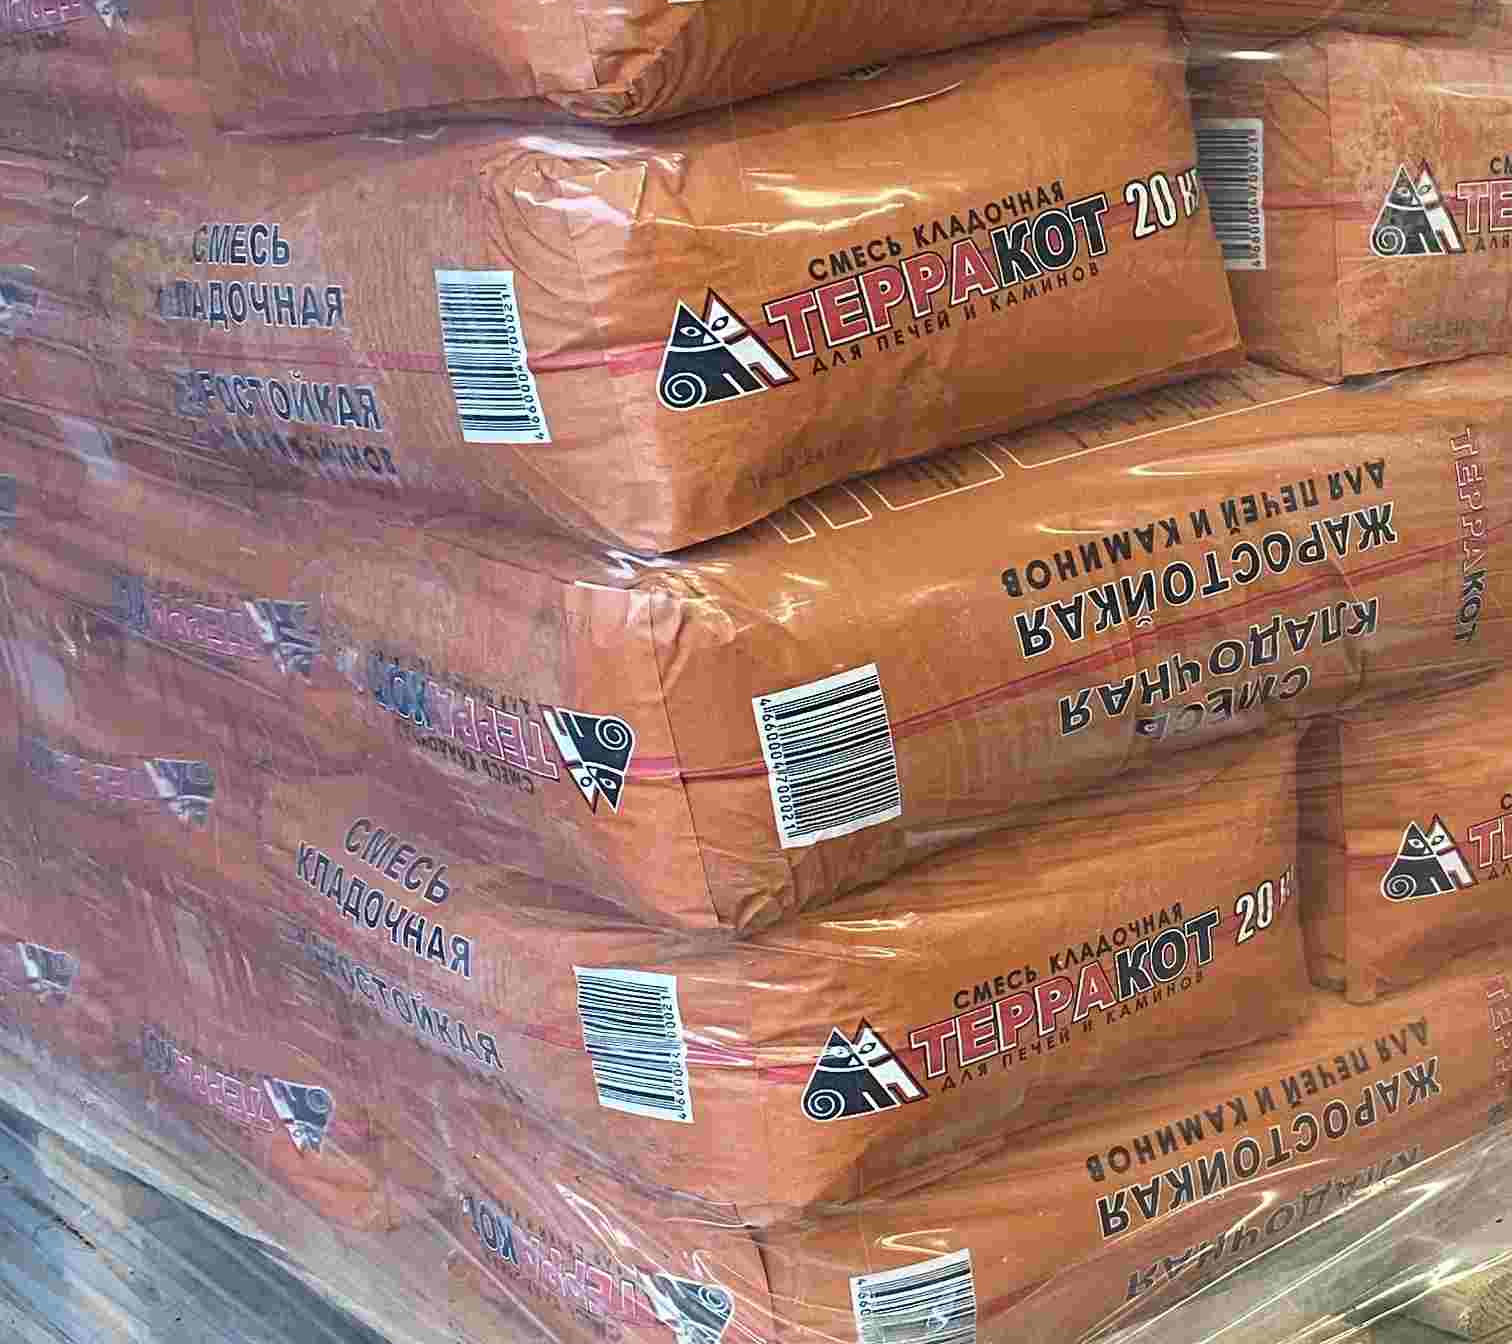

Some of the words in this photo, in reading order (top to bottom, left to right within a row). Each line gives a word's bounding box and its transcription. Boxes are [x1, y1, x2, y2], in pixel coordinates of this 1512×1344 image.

[191, 224, 290, 268] СМЕСЬ
[763, 193, 1109, 358] ТЕРРАКОТ
[1124, 171, 1176, 241] 20
[807, 236, 901, 281] СМЕСЬ
[912, 181, 1065, 247] КЛАДОЧНАЯ
[1474, 235, 1511, 252] ДЛЯ
[811, 341, 863, 376] ДЛЯ
[876, 312, 952, 351] ПЕЧЕЙ
[964, 301, 977, 321] И
[990, 261, 1100, 313] КАМИНОВ
[1192, 510, 1210, 533] И
[1221, 480, 1319, 532] ПЕЧЕЙ
[1327, 457, 1386, 498] ДЛЯ
[1000, 518, 1182, 597] КАМИНОВ
[1013, 502, 1398, 659] ЖАРОСТОЙКАЯ
[1057, 597, 1378, 737] КЛАДОЧНАЯ
[344, 817, 450, 905] СМЕСЬ
[295, 840, 472, 980] КЛАДОЧНАЯ
[954, 969, 1037, 1012] СМЕСЬ
[1048, 902, 1184, 973] КЛАДОЧНАЯ
[908, 909, 1220, 1080] ТЕРРАКОТ
[1234, 880, 1276, 944] 20
[940, 1062, 991, 1093] ДЛЯ
[999, 1026, 1072, 1075] ПЕЧЕЙ
[1106, 972, 1203, 1025] КАМИНОВ
[1285, 1045, 1366, 1105] ПЕЧЕЙ
[1373, 1017, 1431, 1067] ДЛЯ
[1086, 1095, 1250, 1183] КАМИНОВ
[1094, 1056, 1442, 1241] ЖАРОСТОЙКАЯ
